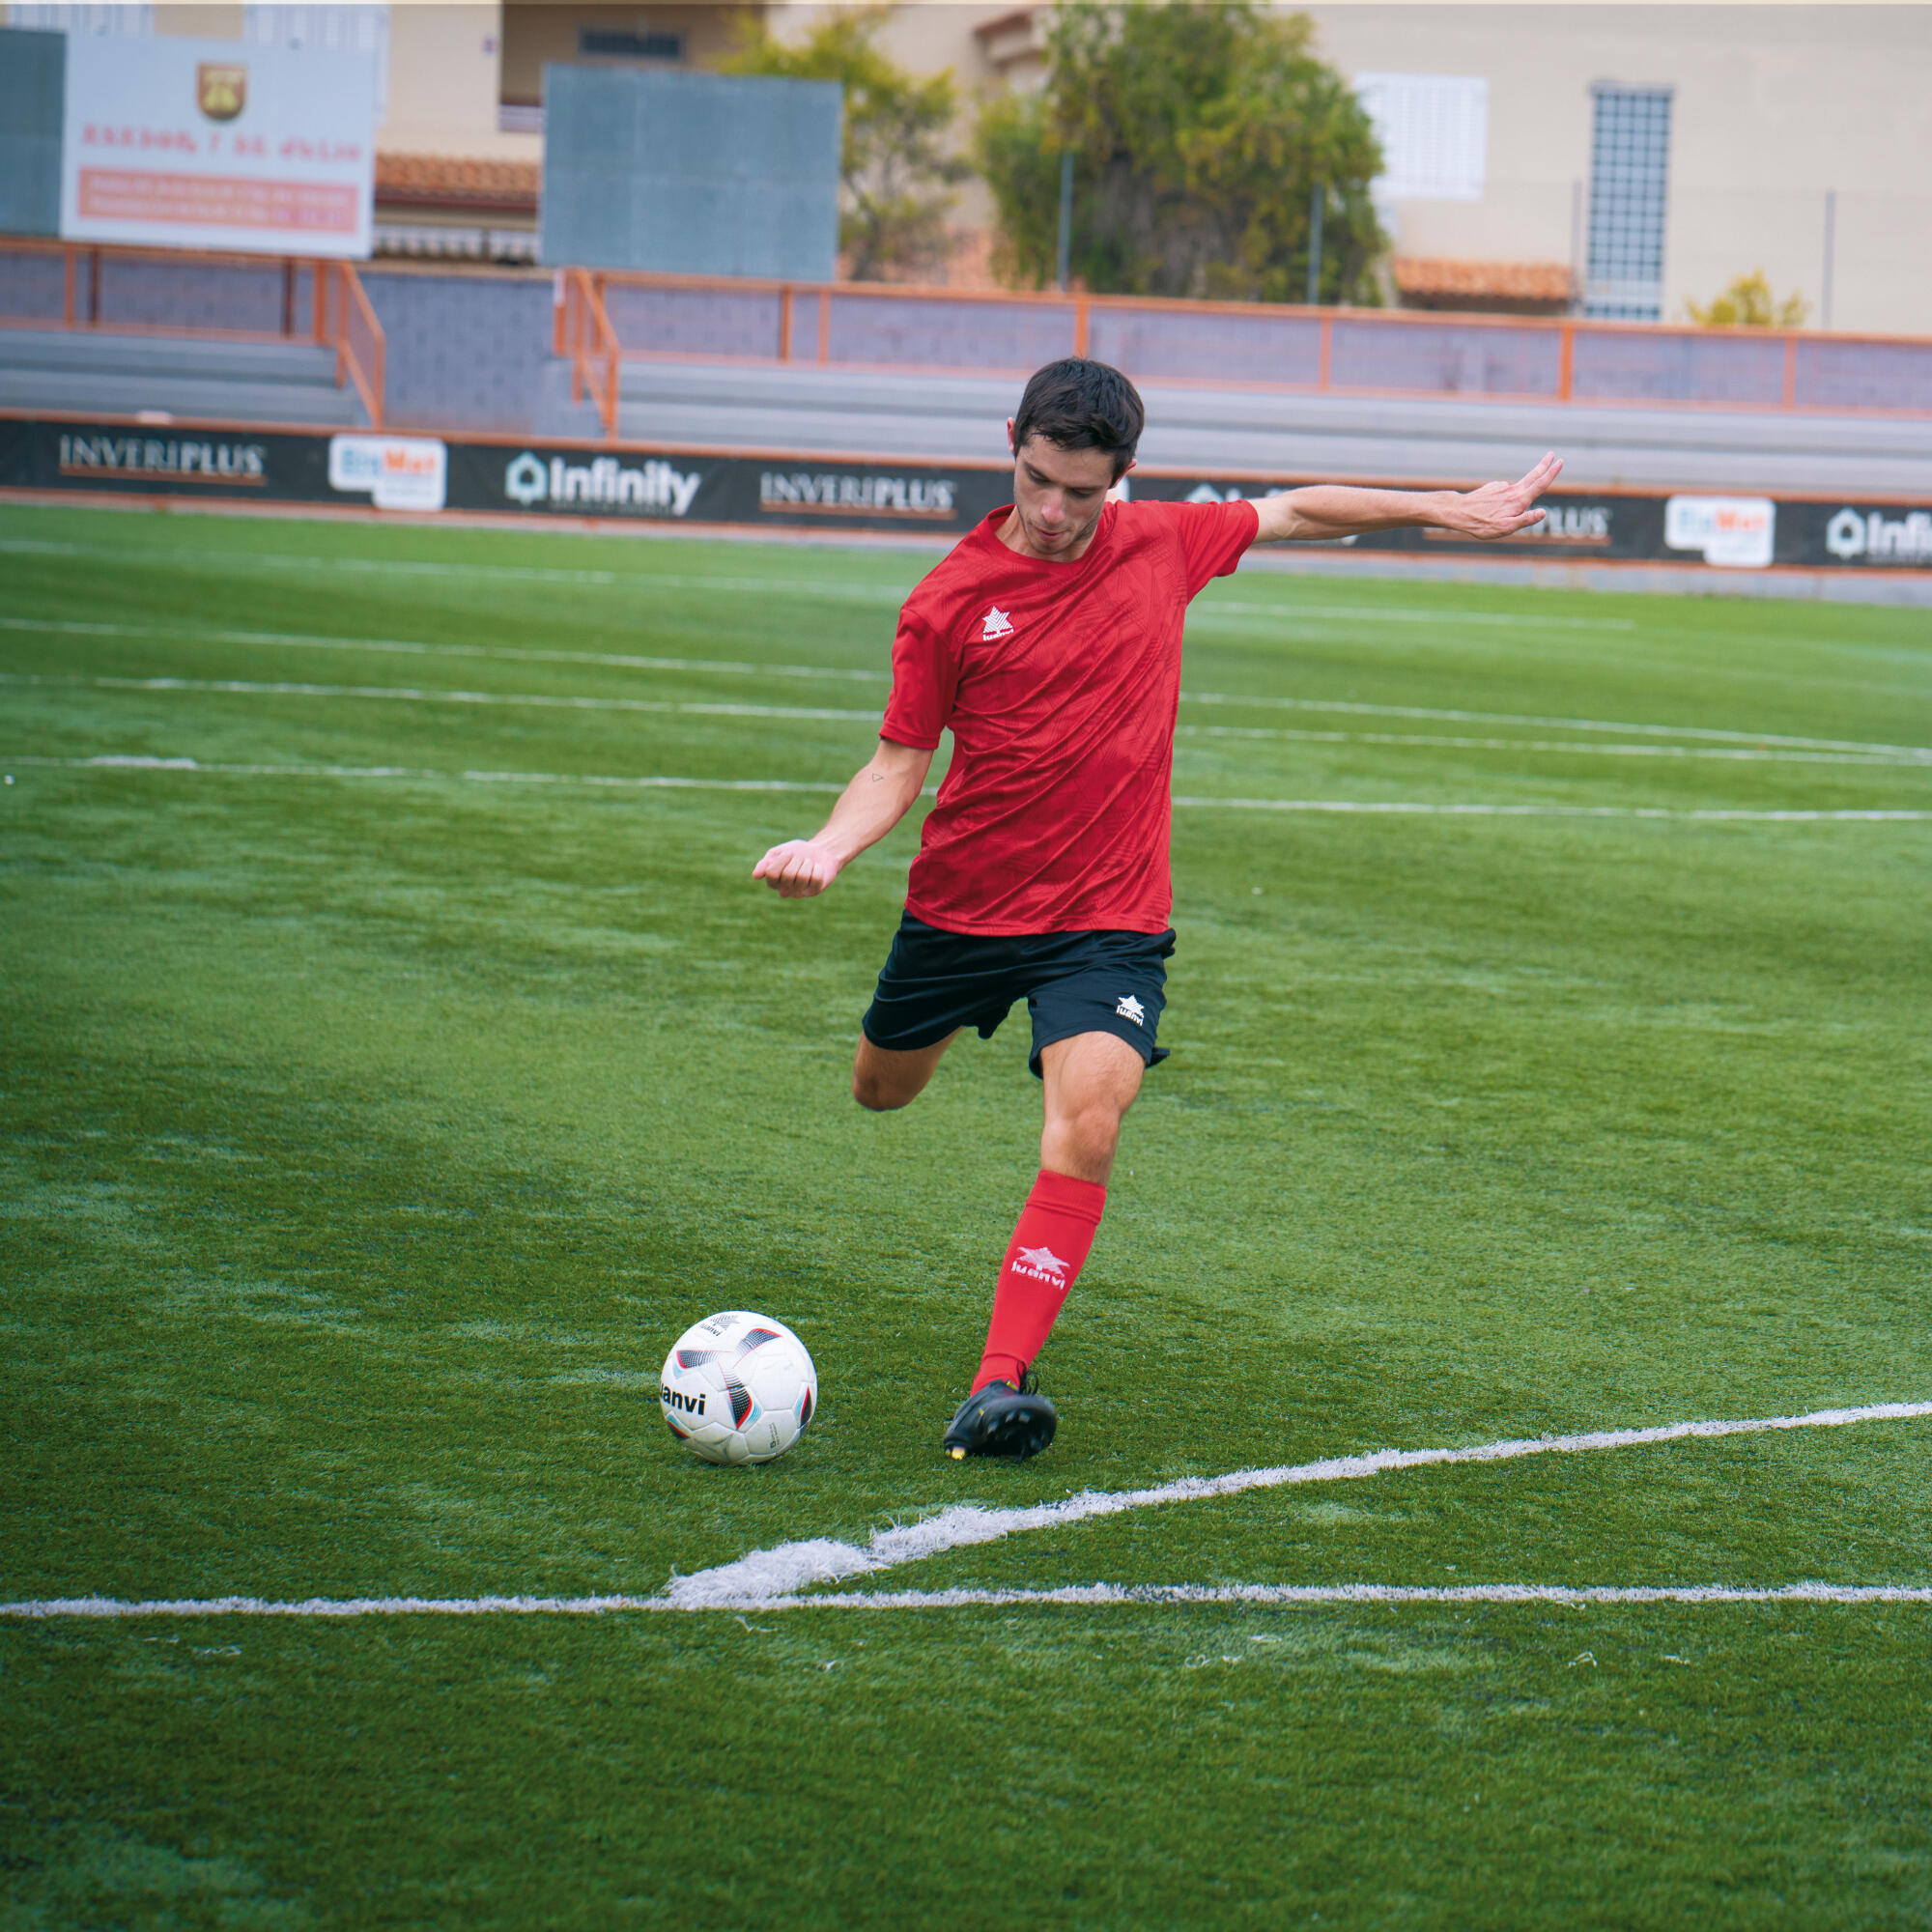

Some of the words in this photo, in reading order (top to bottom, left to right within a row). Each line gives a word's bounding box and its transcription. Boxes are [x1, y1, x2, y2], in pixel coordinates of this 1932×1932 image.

[60, 434, 266, 479] INVERIPLUS
[550, 456, 702, 517] Infinity
[760, 471, 957, 513] INVERIPLUS
[1011, 1260, 1065, 1290] luanvi
